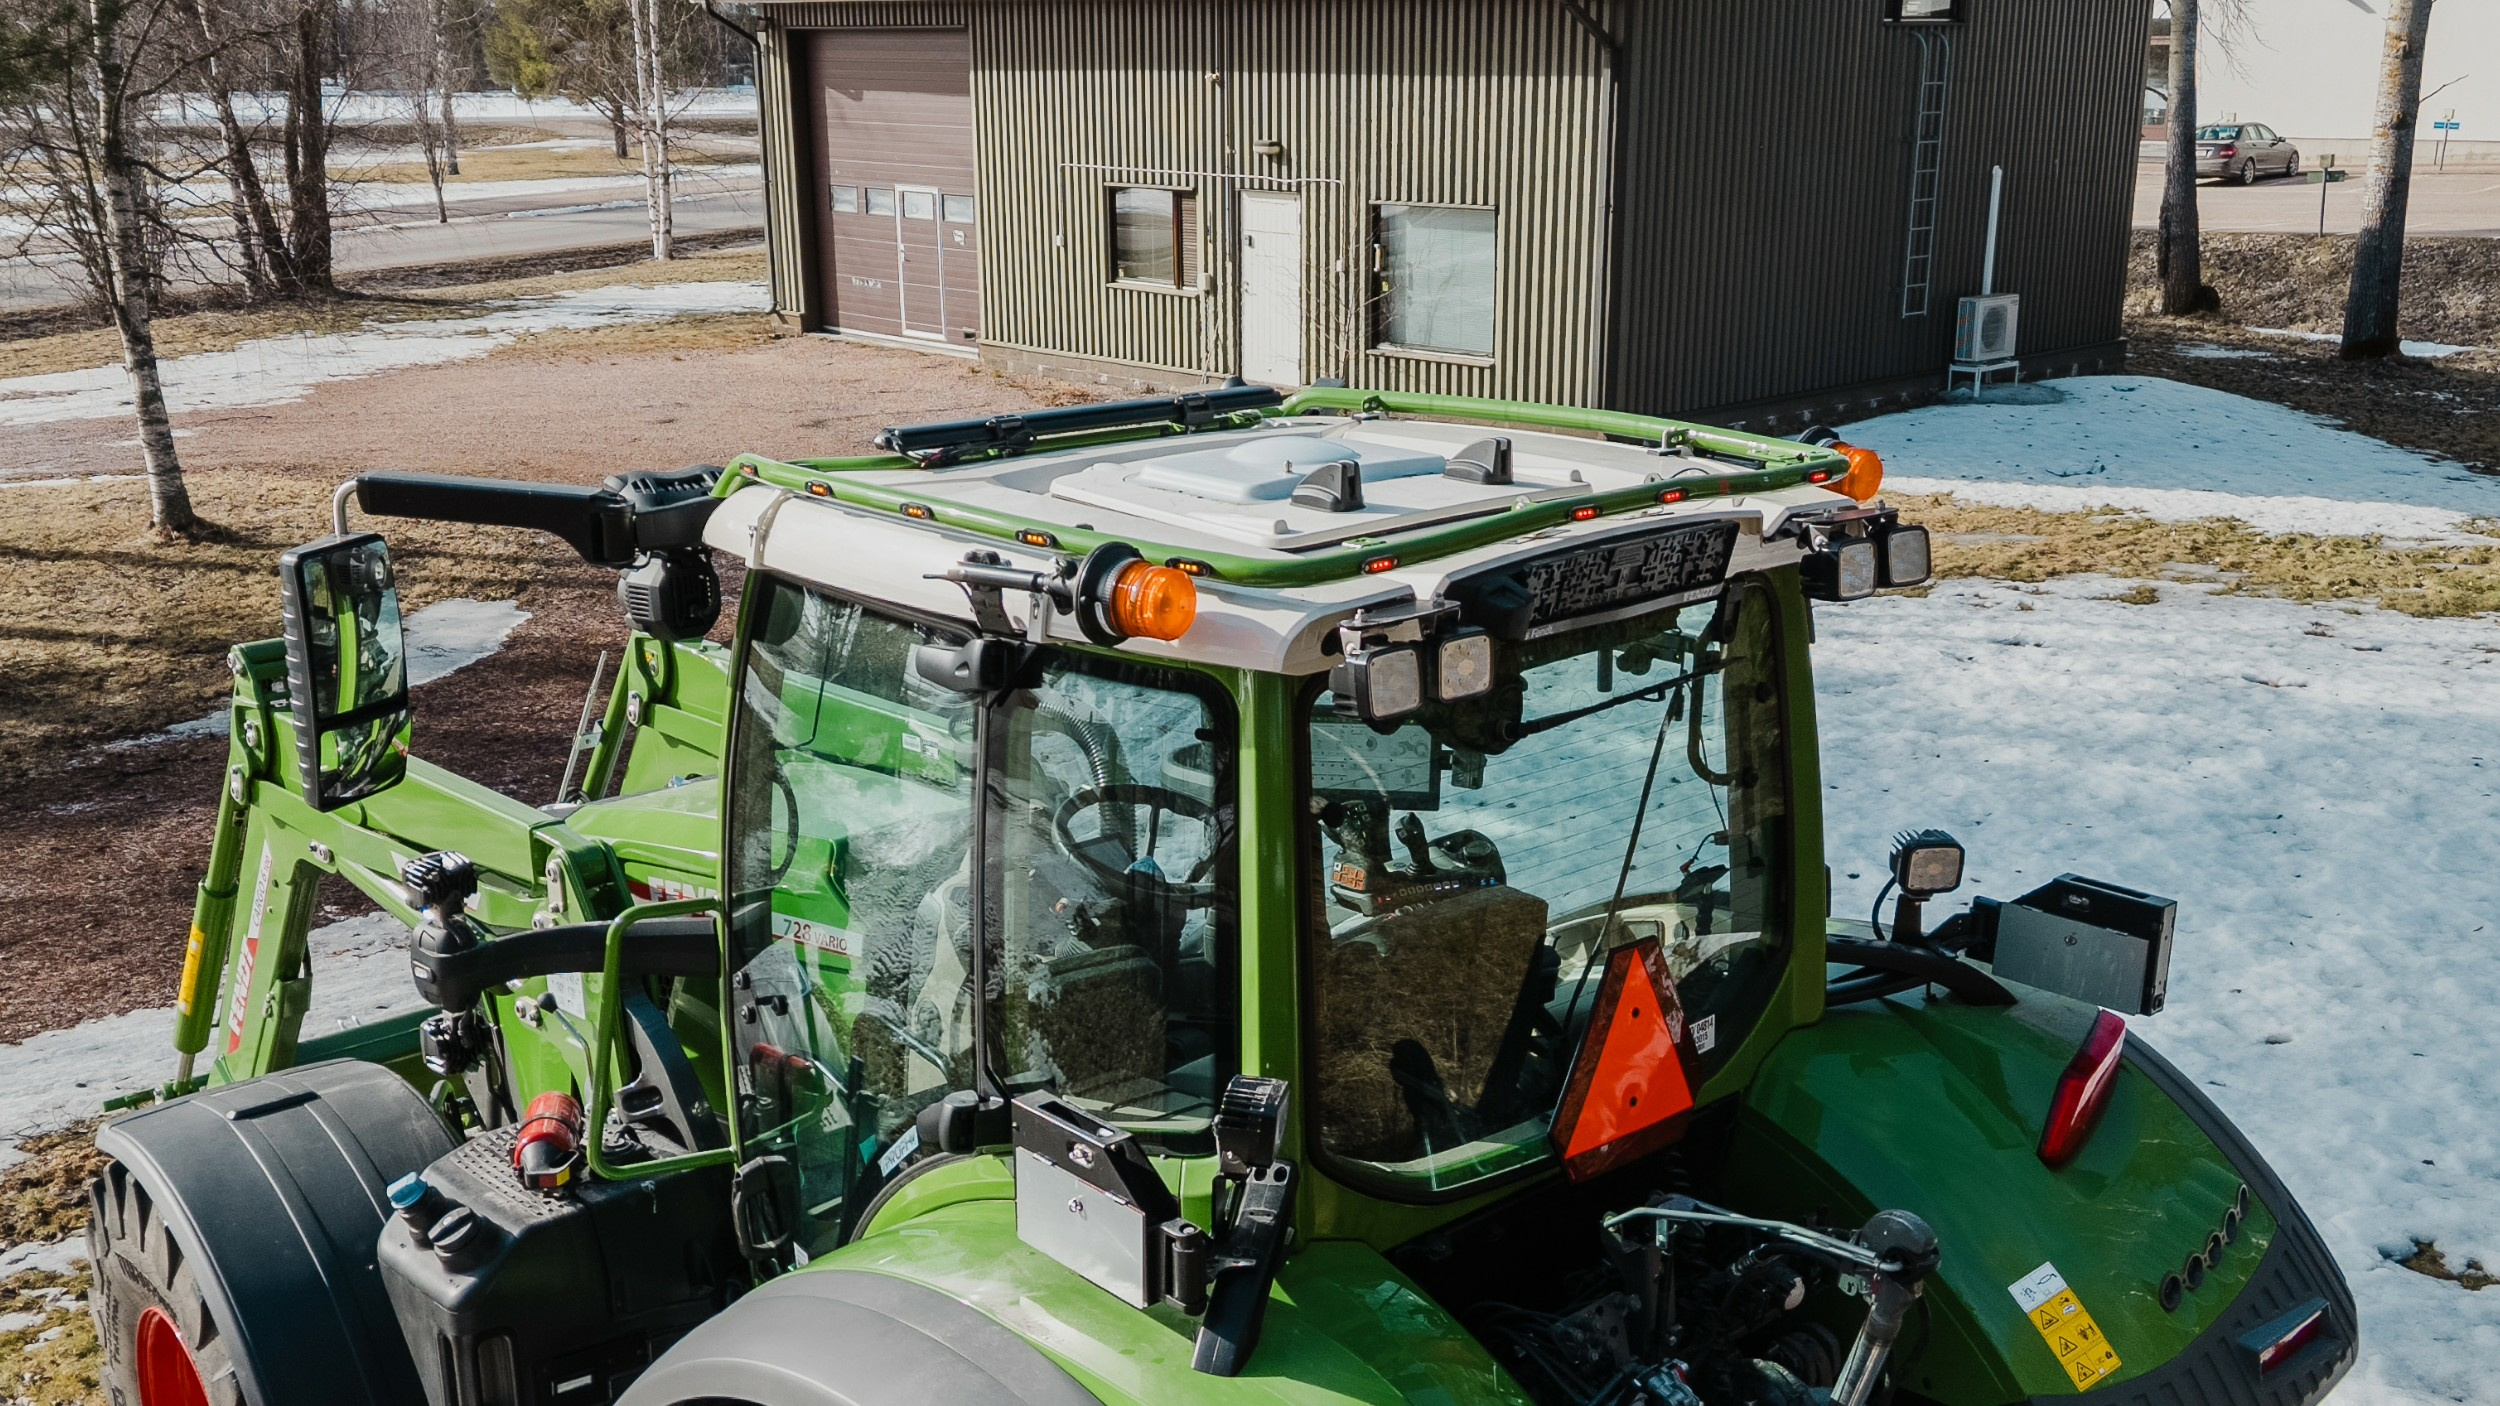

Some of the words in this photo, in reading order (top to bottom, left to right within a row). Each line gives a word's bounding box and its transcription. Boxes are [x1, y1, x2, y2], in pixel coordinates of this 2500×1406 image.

[252, 880, 266, 927] CARGO
[783, 918, 812, 941] 728
[814, 931, 848, 951] VARIO
[228, 933, 254, 1037] FENDT
